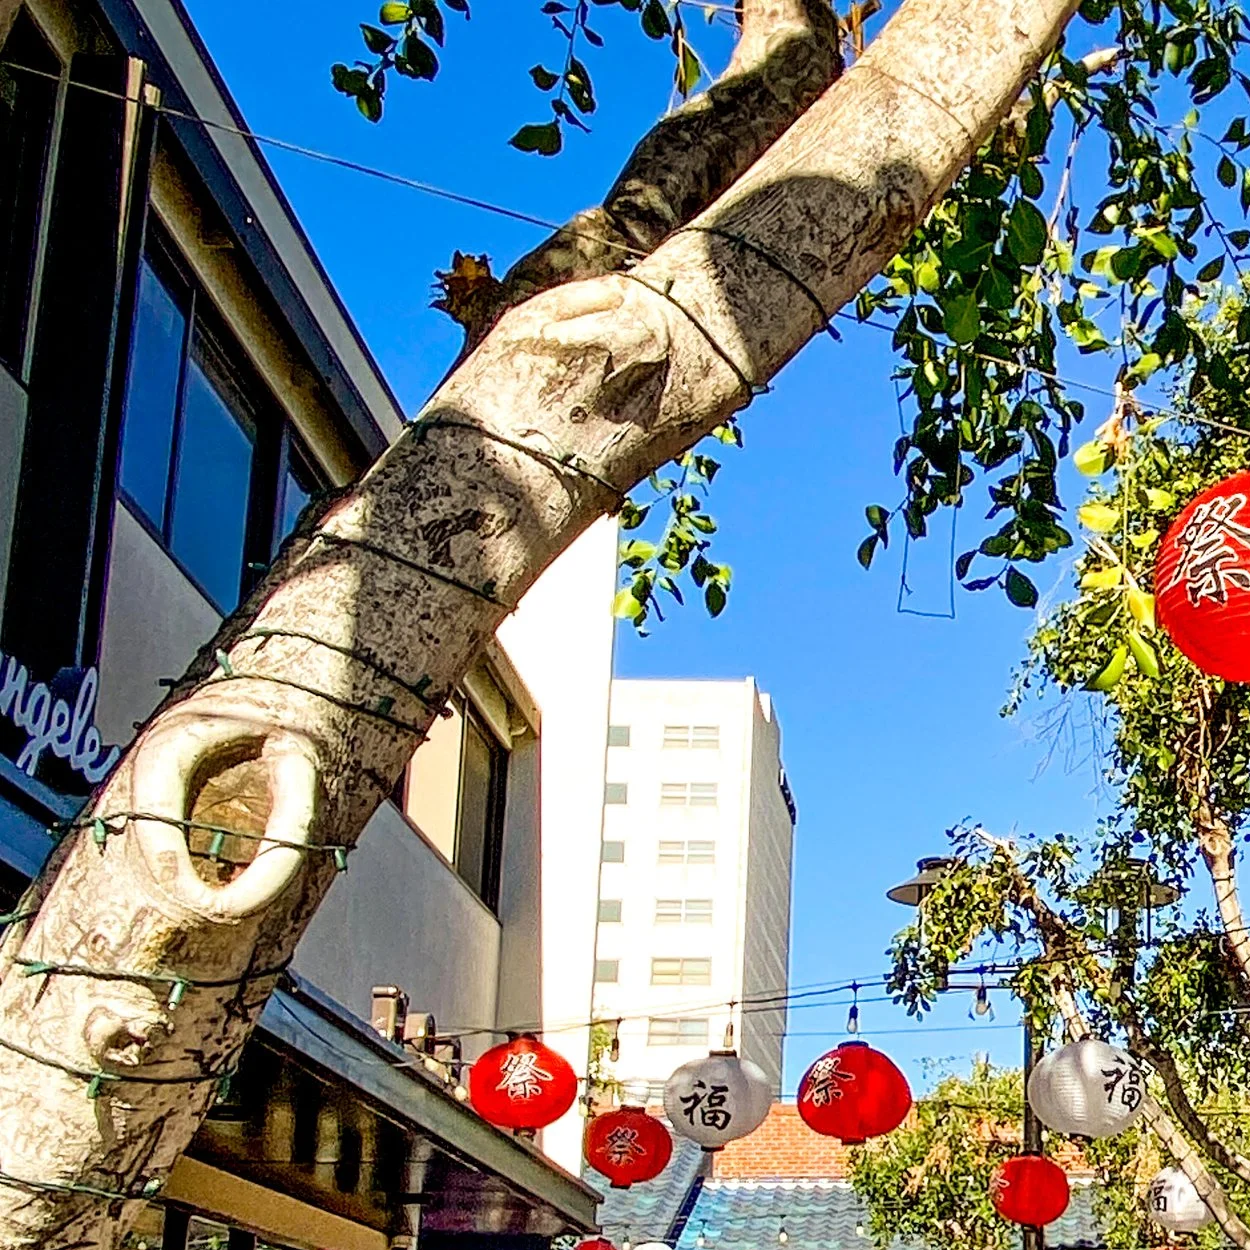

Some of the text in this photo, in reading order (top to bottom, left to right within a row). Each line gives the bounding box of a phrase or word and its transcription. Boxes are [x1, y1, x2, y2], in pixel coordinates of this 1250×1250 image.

[0, 650, 120, 783] ngele
[495, 1053, 553, 1099] 祭
[803, 1056, 856, 1107] 祭
[1101, 1055, 1151, 1113] 福
[680, 1080, 733, 1131] 福
